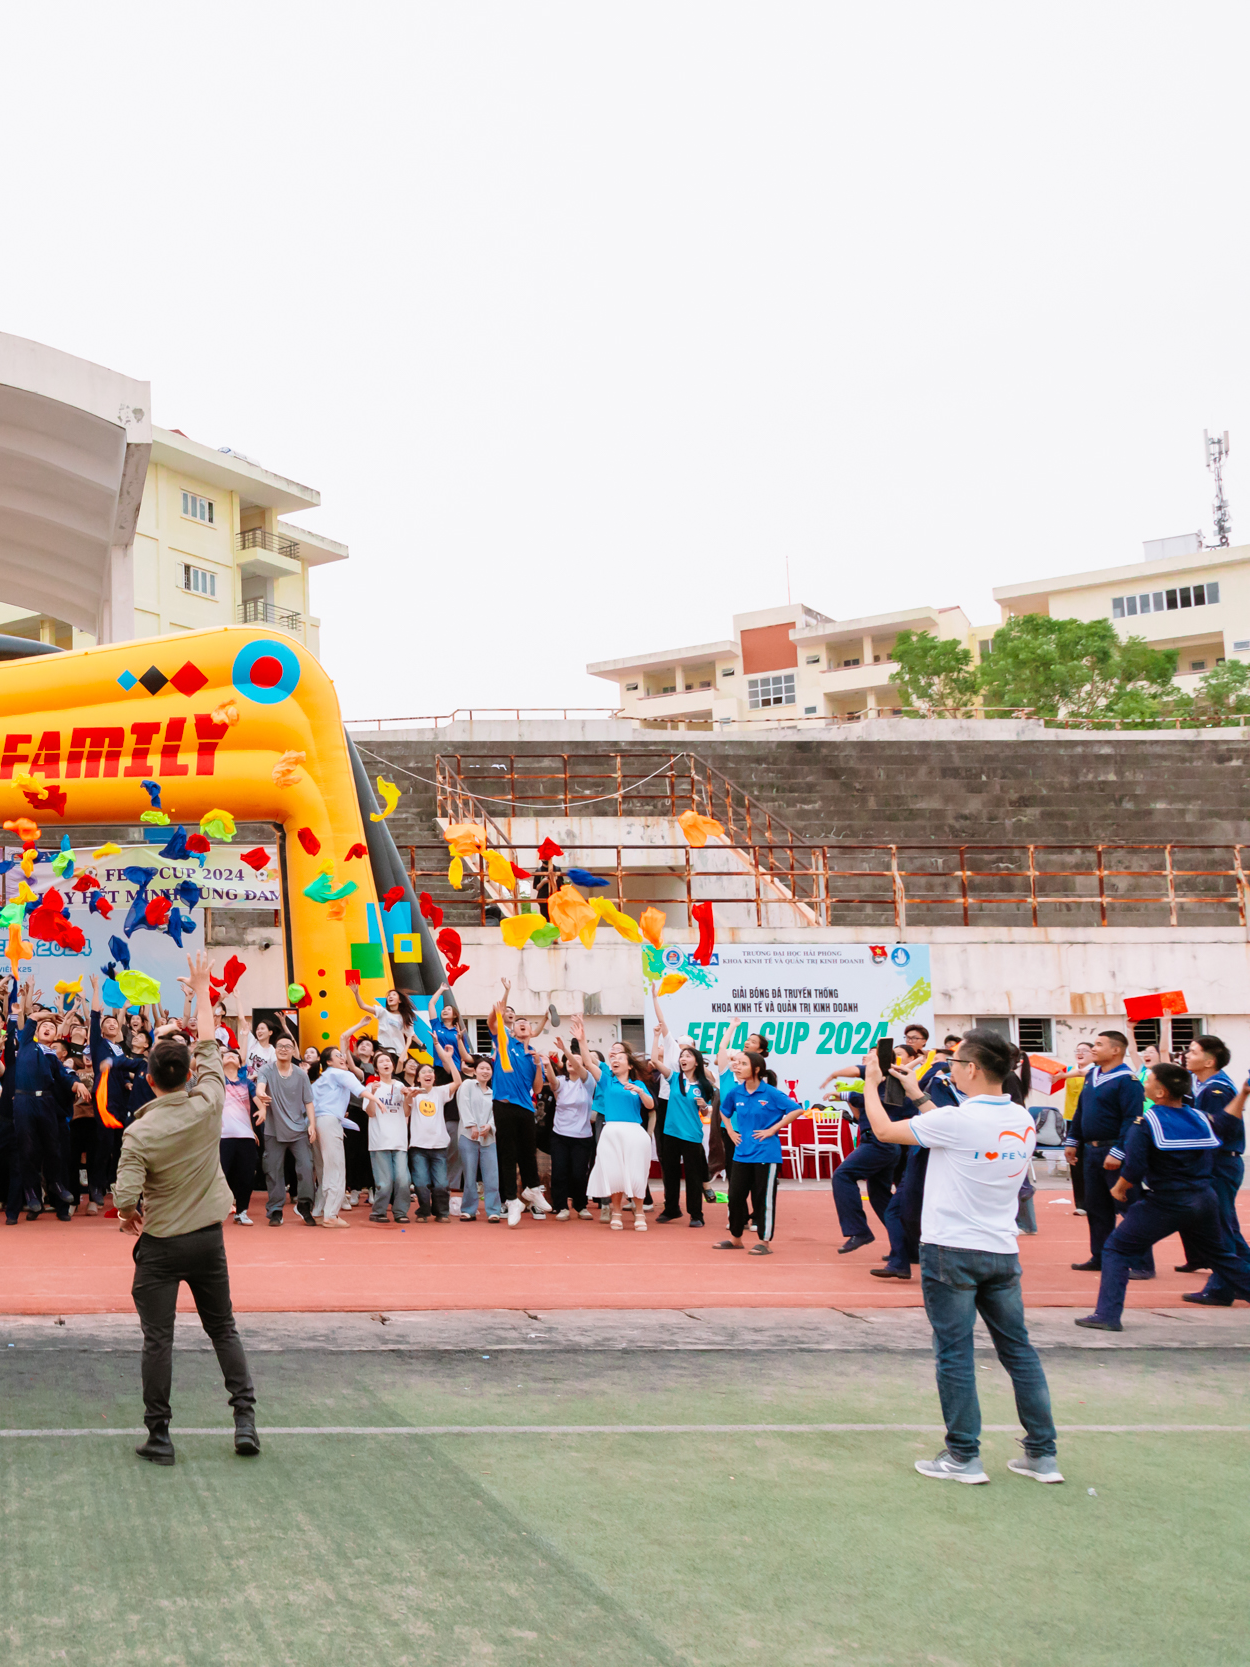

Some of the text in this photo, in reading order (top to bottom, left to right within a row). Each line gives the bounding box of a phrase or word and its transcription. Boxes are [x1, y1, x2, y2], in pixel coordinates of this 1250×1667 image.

[159, 867, 196, 880] CUP
[202, 867, 245, 881] 2024
[198, 884, 238, 901] ÙNG
[732, 986, 747, 998] GIẢI
[749, 987, 770, 998] BÓNG
[771, 987, 782, 998] ĐÁ
[711, 1000, 859, 1015] KHOA KINH TẾ VÀ QUẢN TRỊ KINH DOANH
[759, 1021, 810, 1055] CUP
[815, 1021, 889, 1055] 2024
